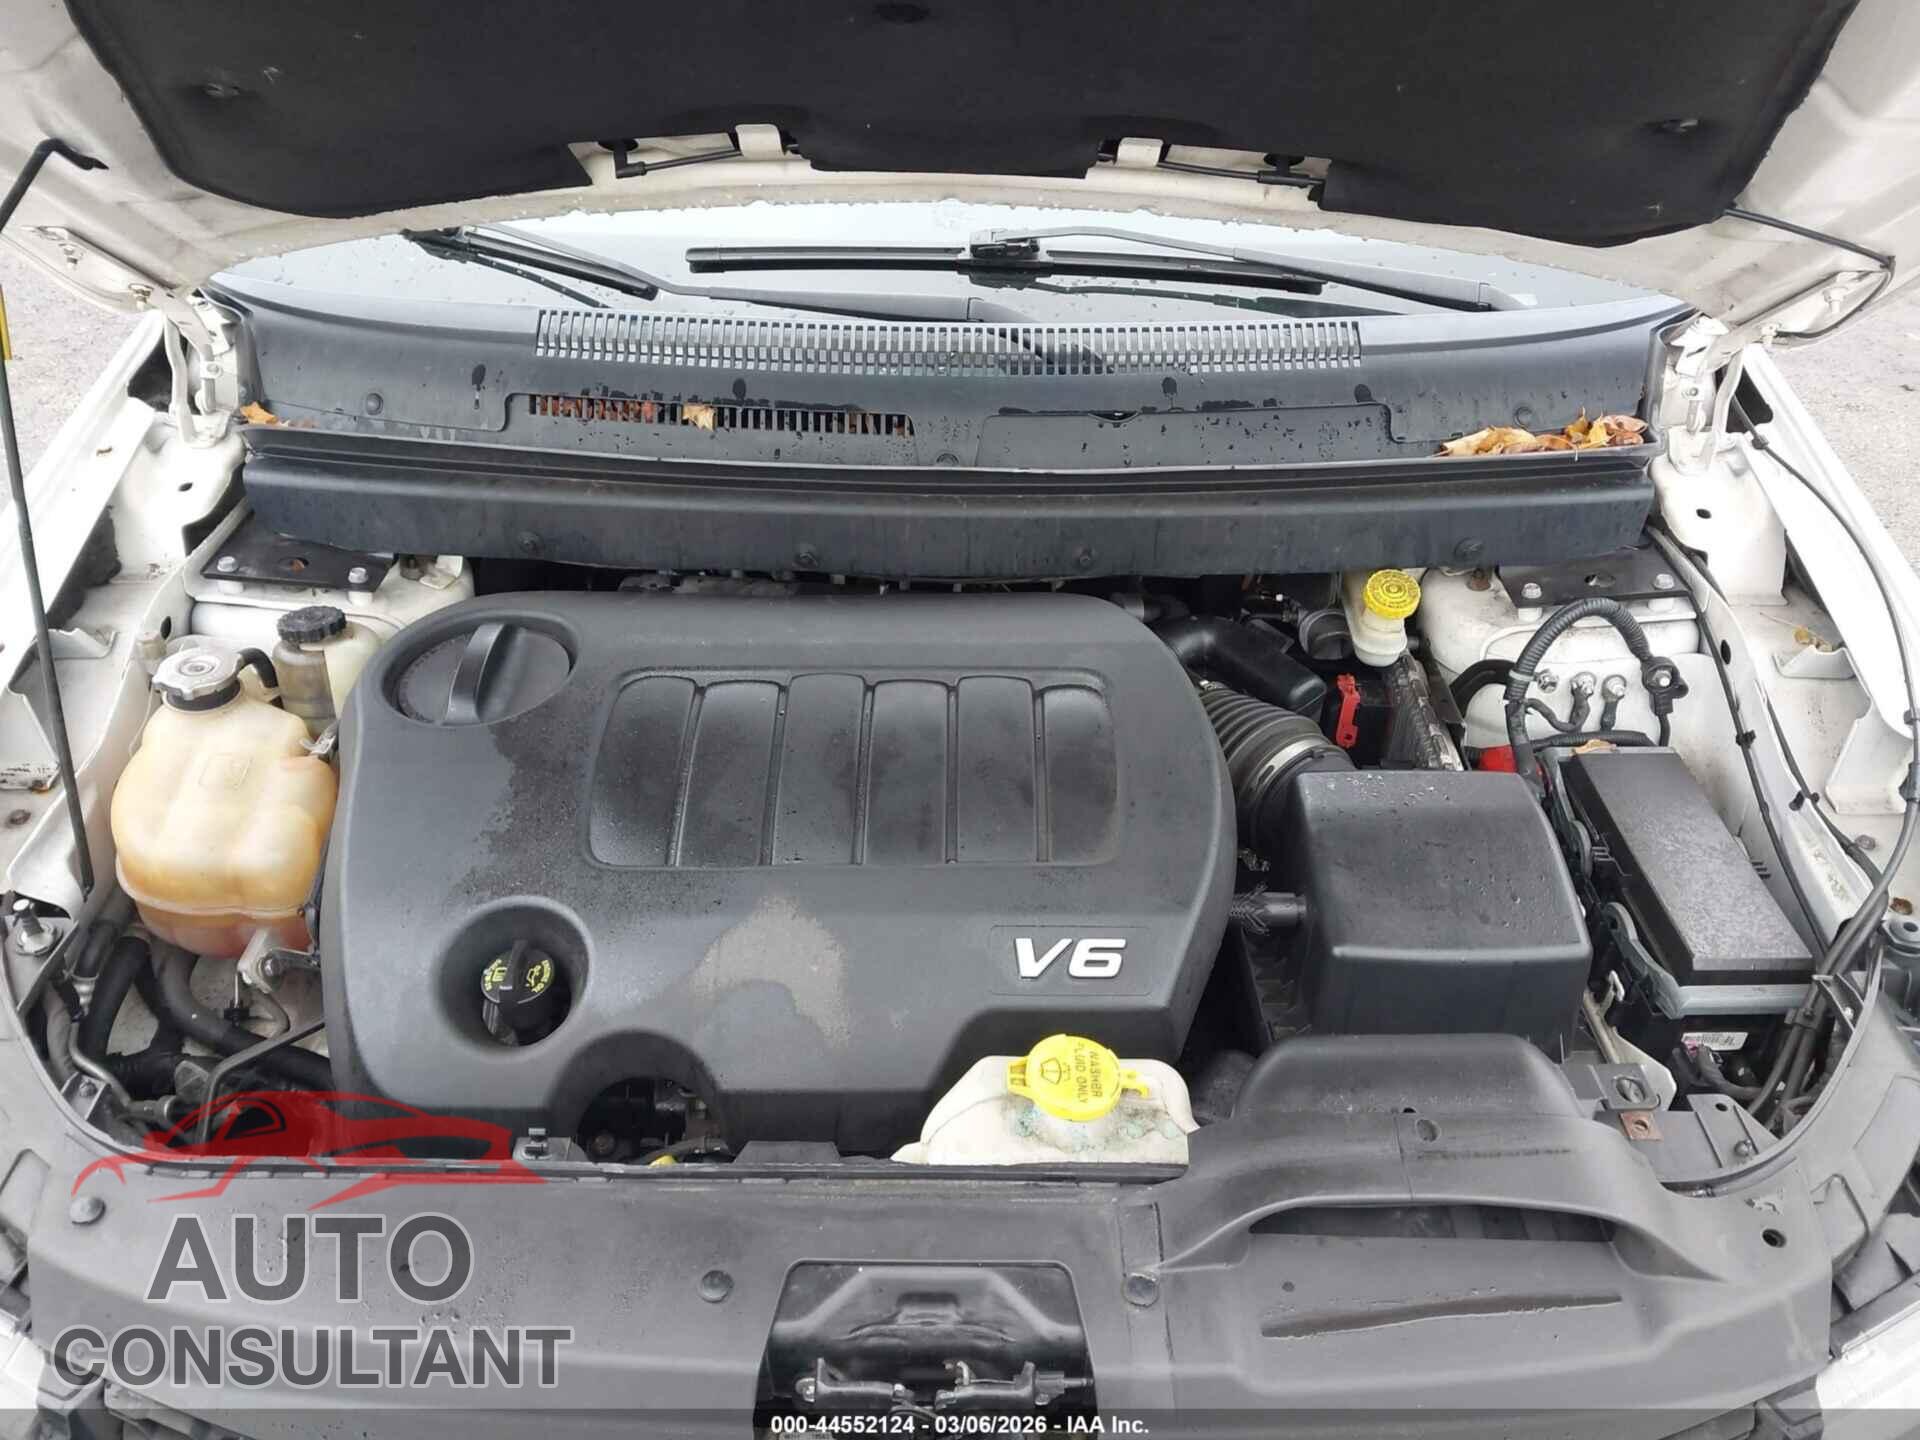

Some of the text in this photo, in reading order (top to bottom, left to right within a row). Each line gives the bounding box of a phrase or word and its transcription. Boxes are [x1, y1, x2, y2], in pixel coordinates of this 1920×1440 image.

[1014, 937, 1127, 979] V6
[1075, 1076, 1089, 1103] ONLY
[1089, 1050, 1103, 1097] WASHER
